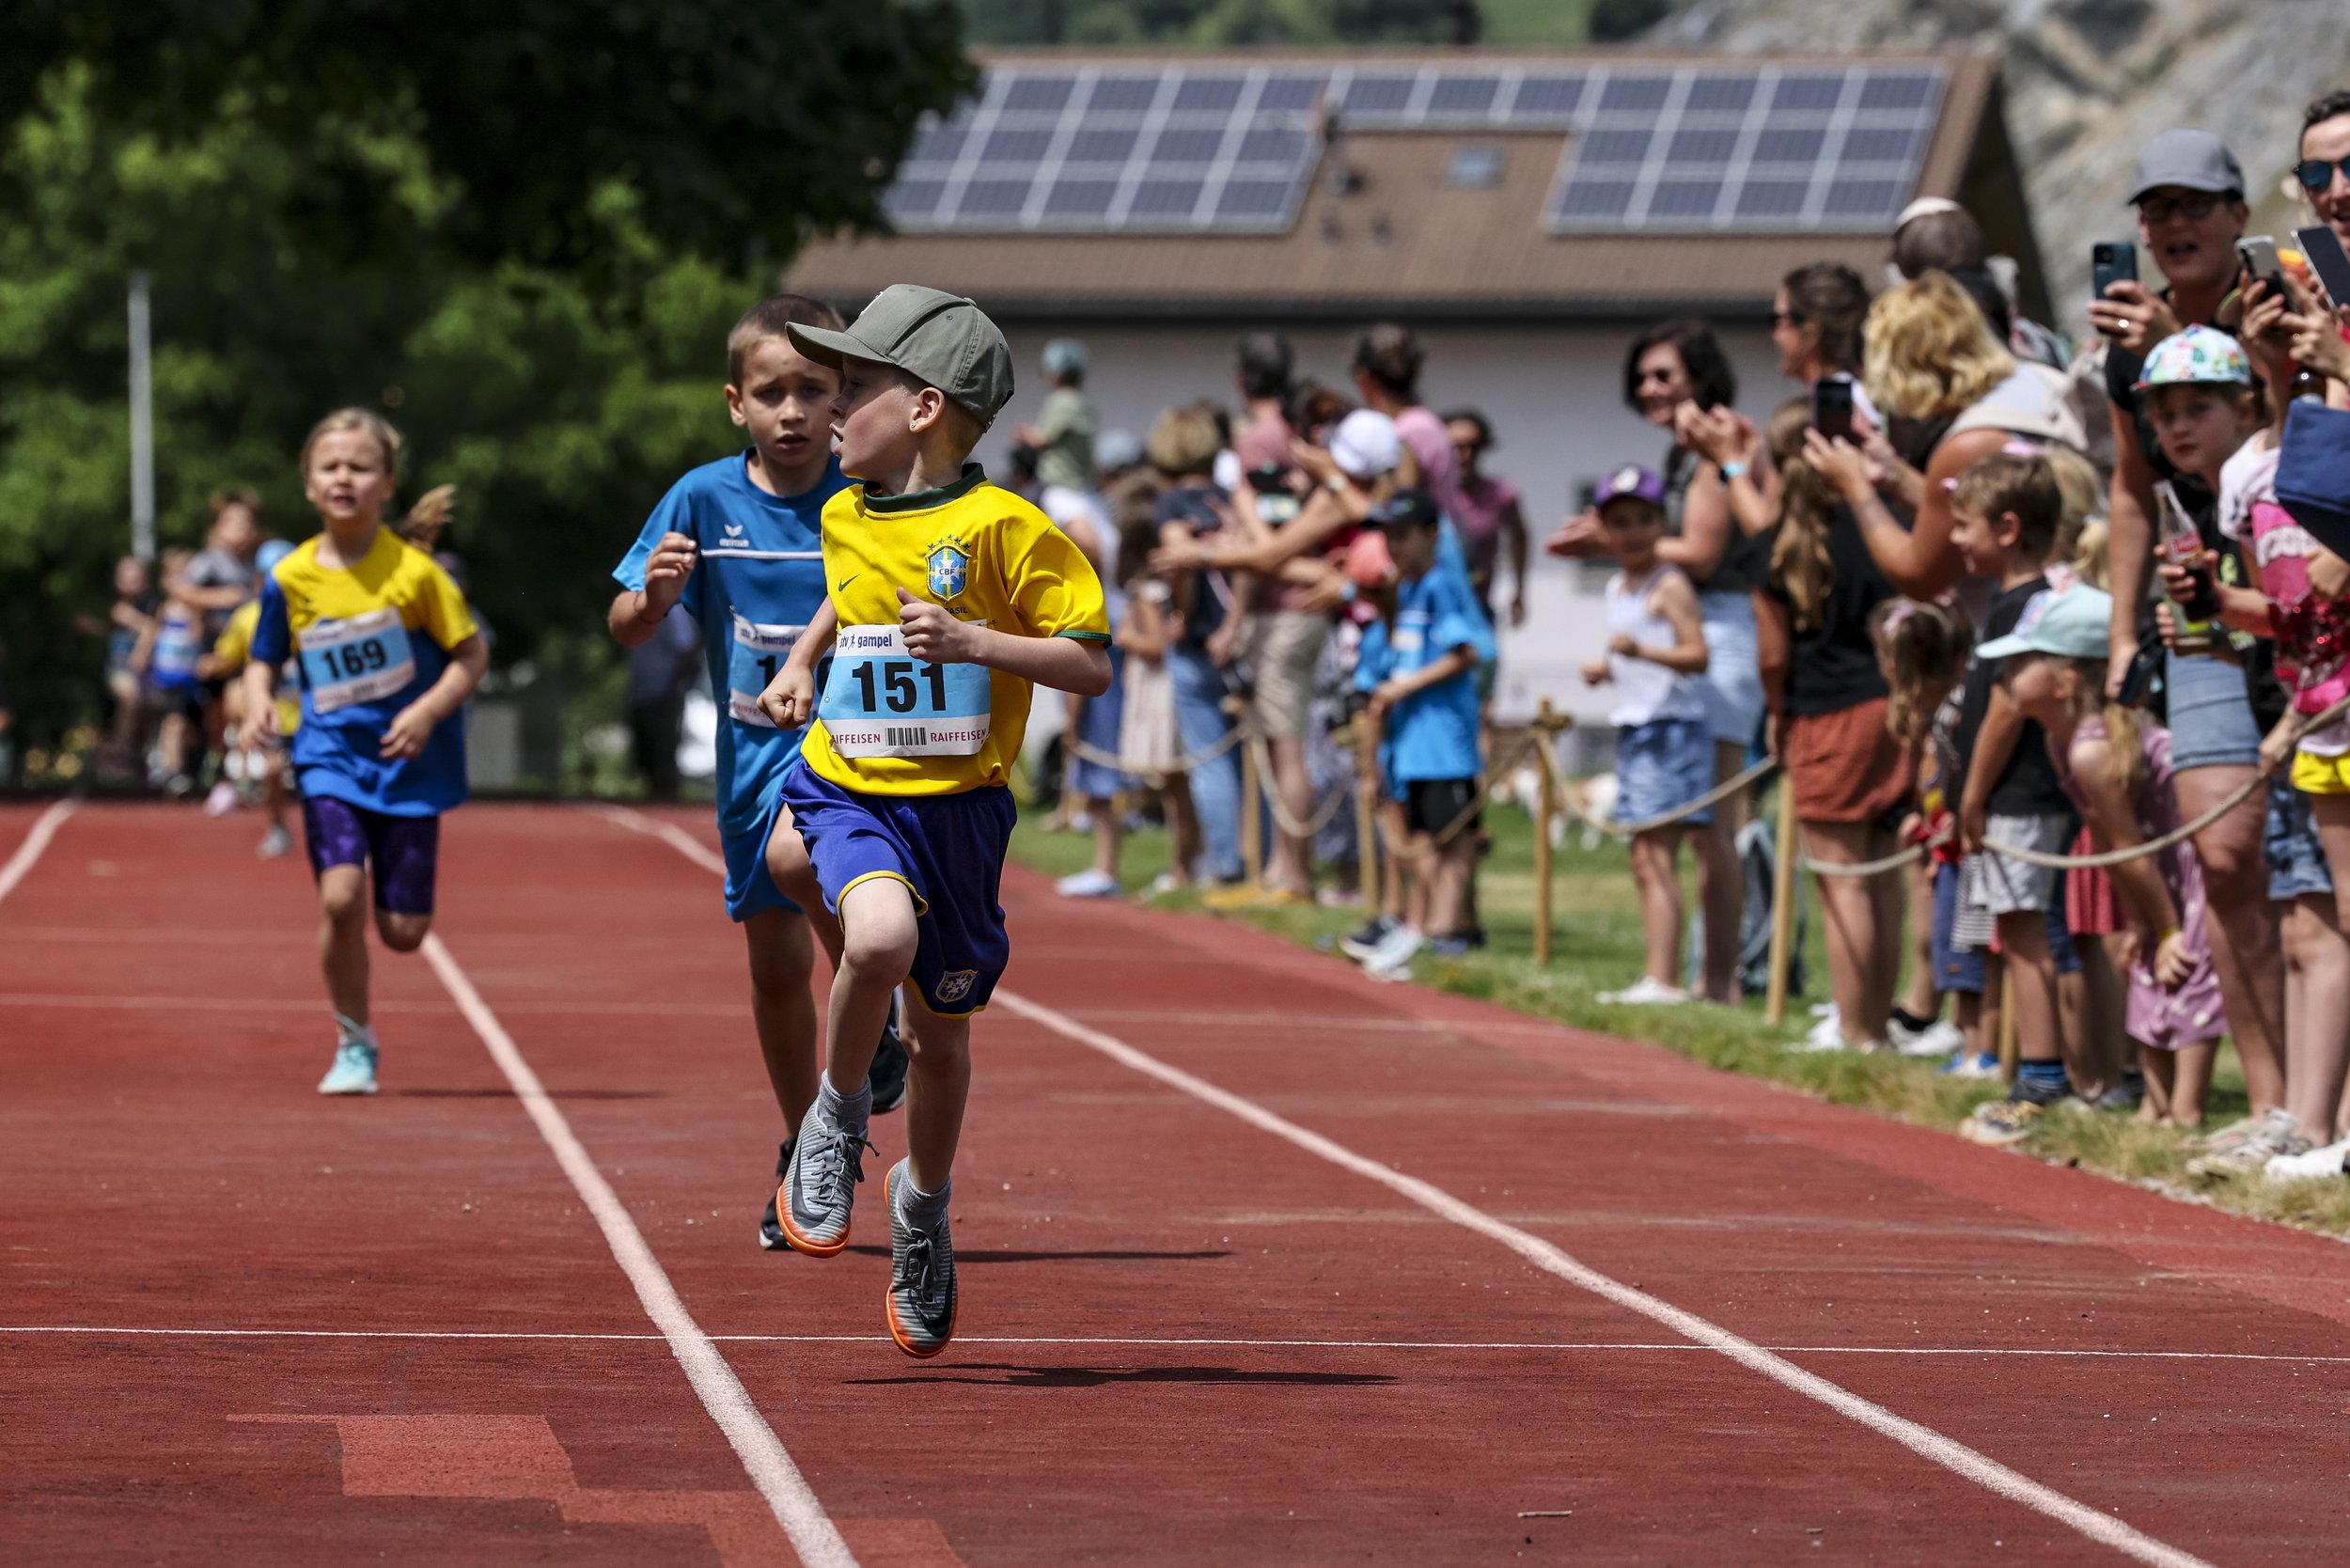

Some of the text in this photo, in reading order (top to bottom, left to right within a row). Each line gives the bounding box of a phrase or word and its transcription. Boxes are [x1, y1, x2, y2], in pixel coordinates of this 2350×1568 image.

[857, 634, 892, 649] gampel
[321, 638, 386, 680] 169
[852, 661, 947, 713] 151
[831, 733, 881, 745] AIFFEISEN
[931, 728, 987, 743] RAIFFEISEN
